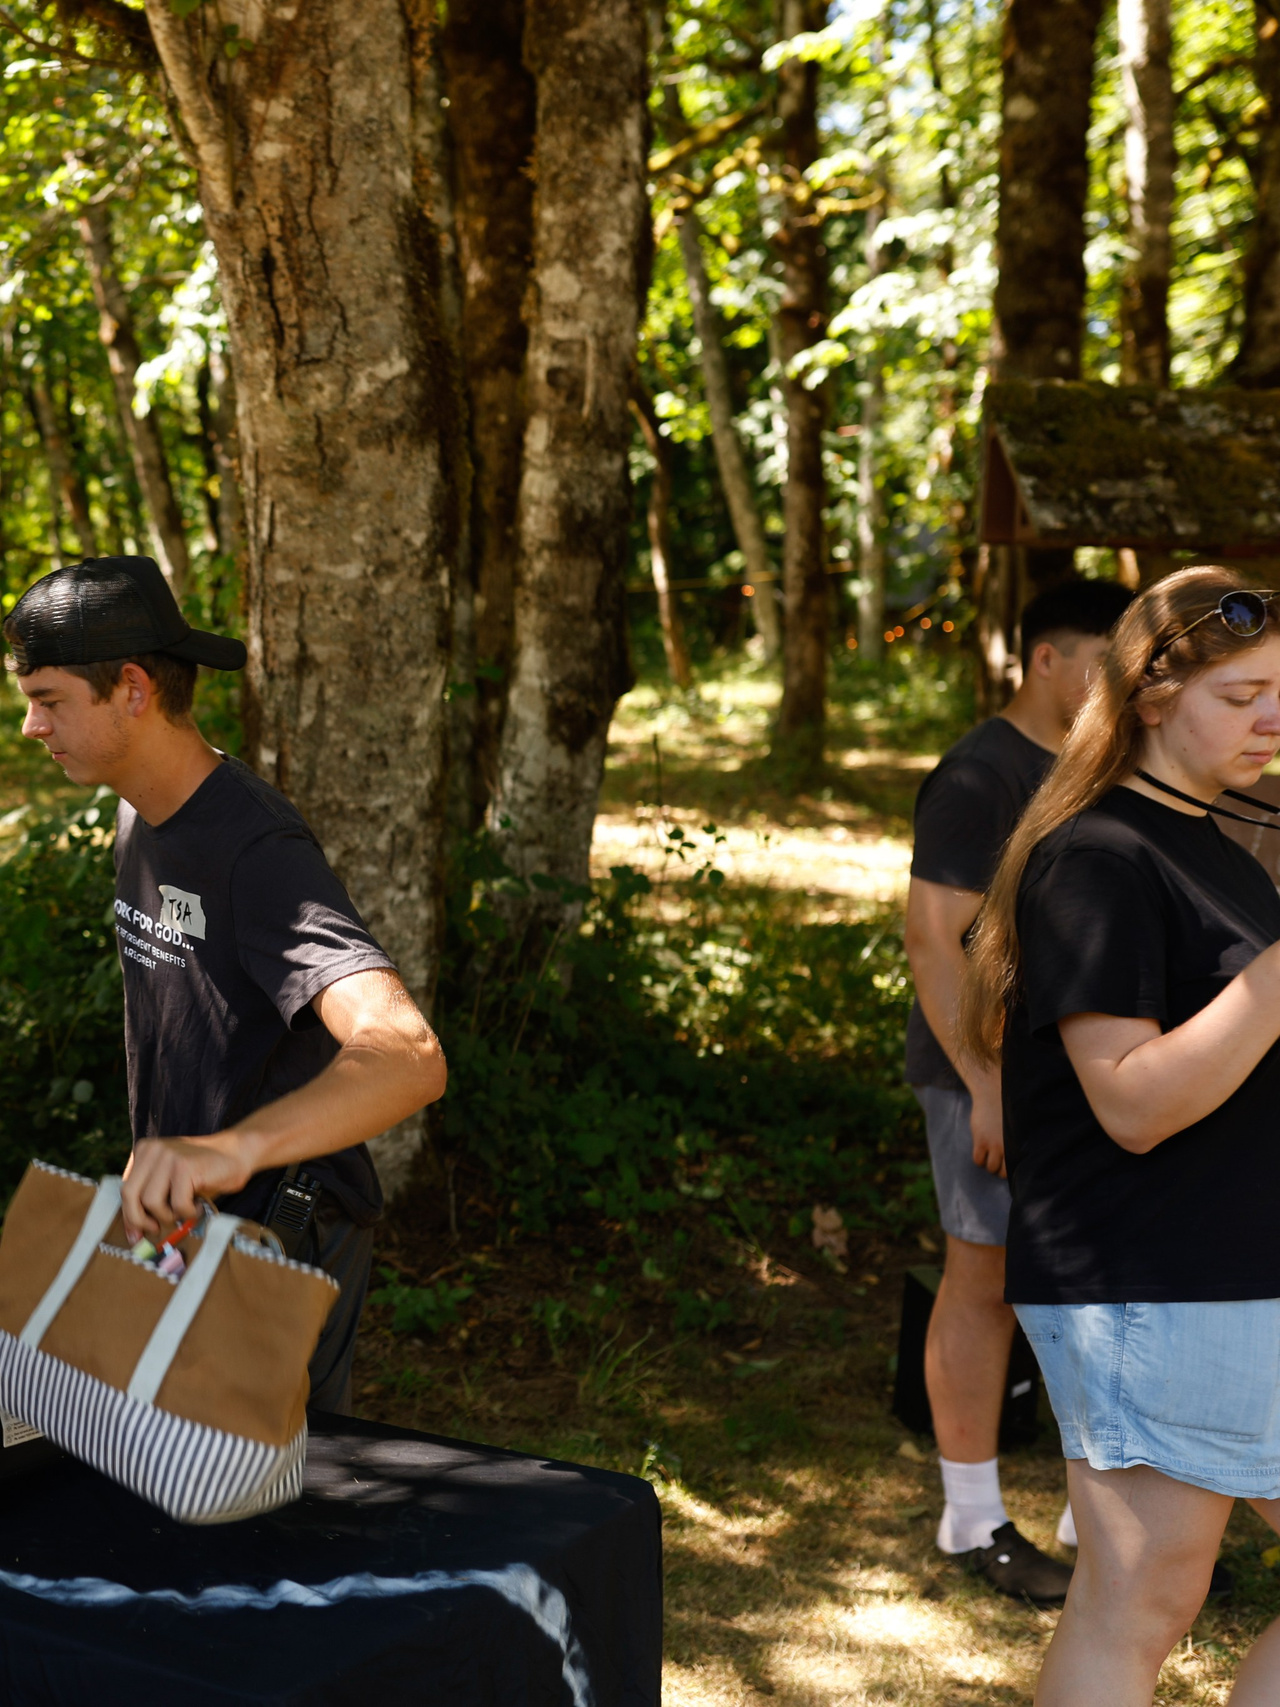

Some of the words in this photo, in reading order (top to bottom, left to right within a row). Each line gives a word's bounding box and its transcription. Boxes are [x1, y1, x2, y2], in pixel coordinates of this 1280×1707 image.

[114, 899, 132, 921] ORK
[132, 909, 153, 934] FOR
[169, 898, 192, 925] TSA
[151, 946, 186, 968] BENEFITS
